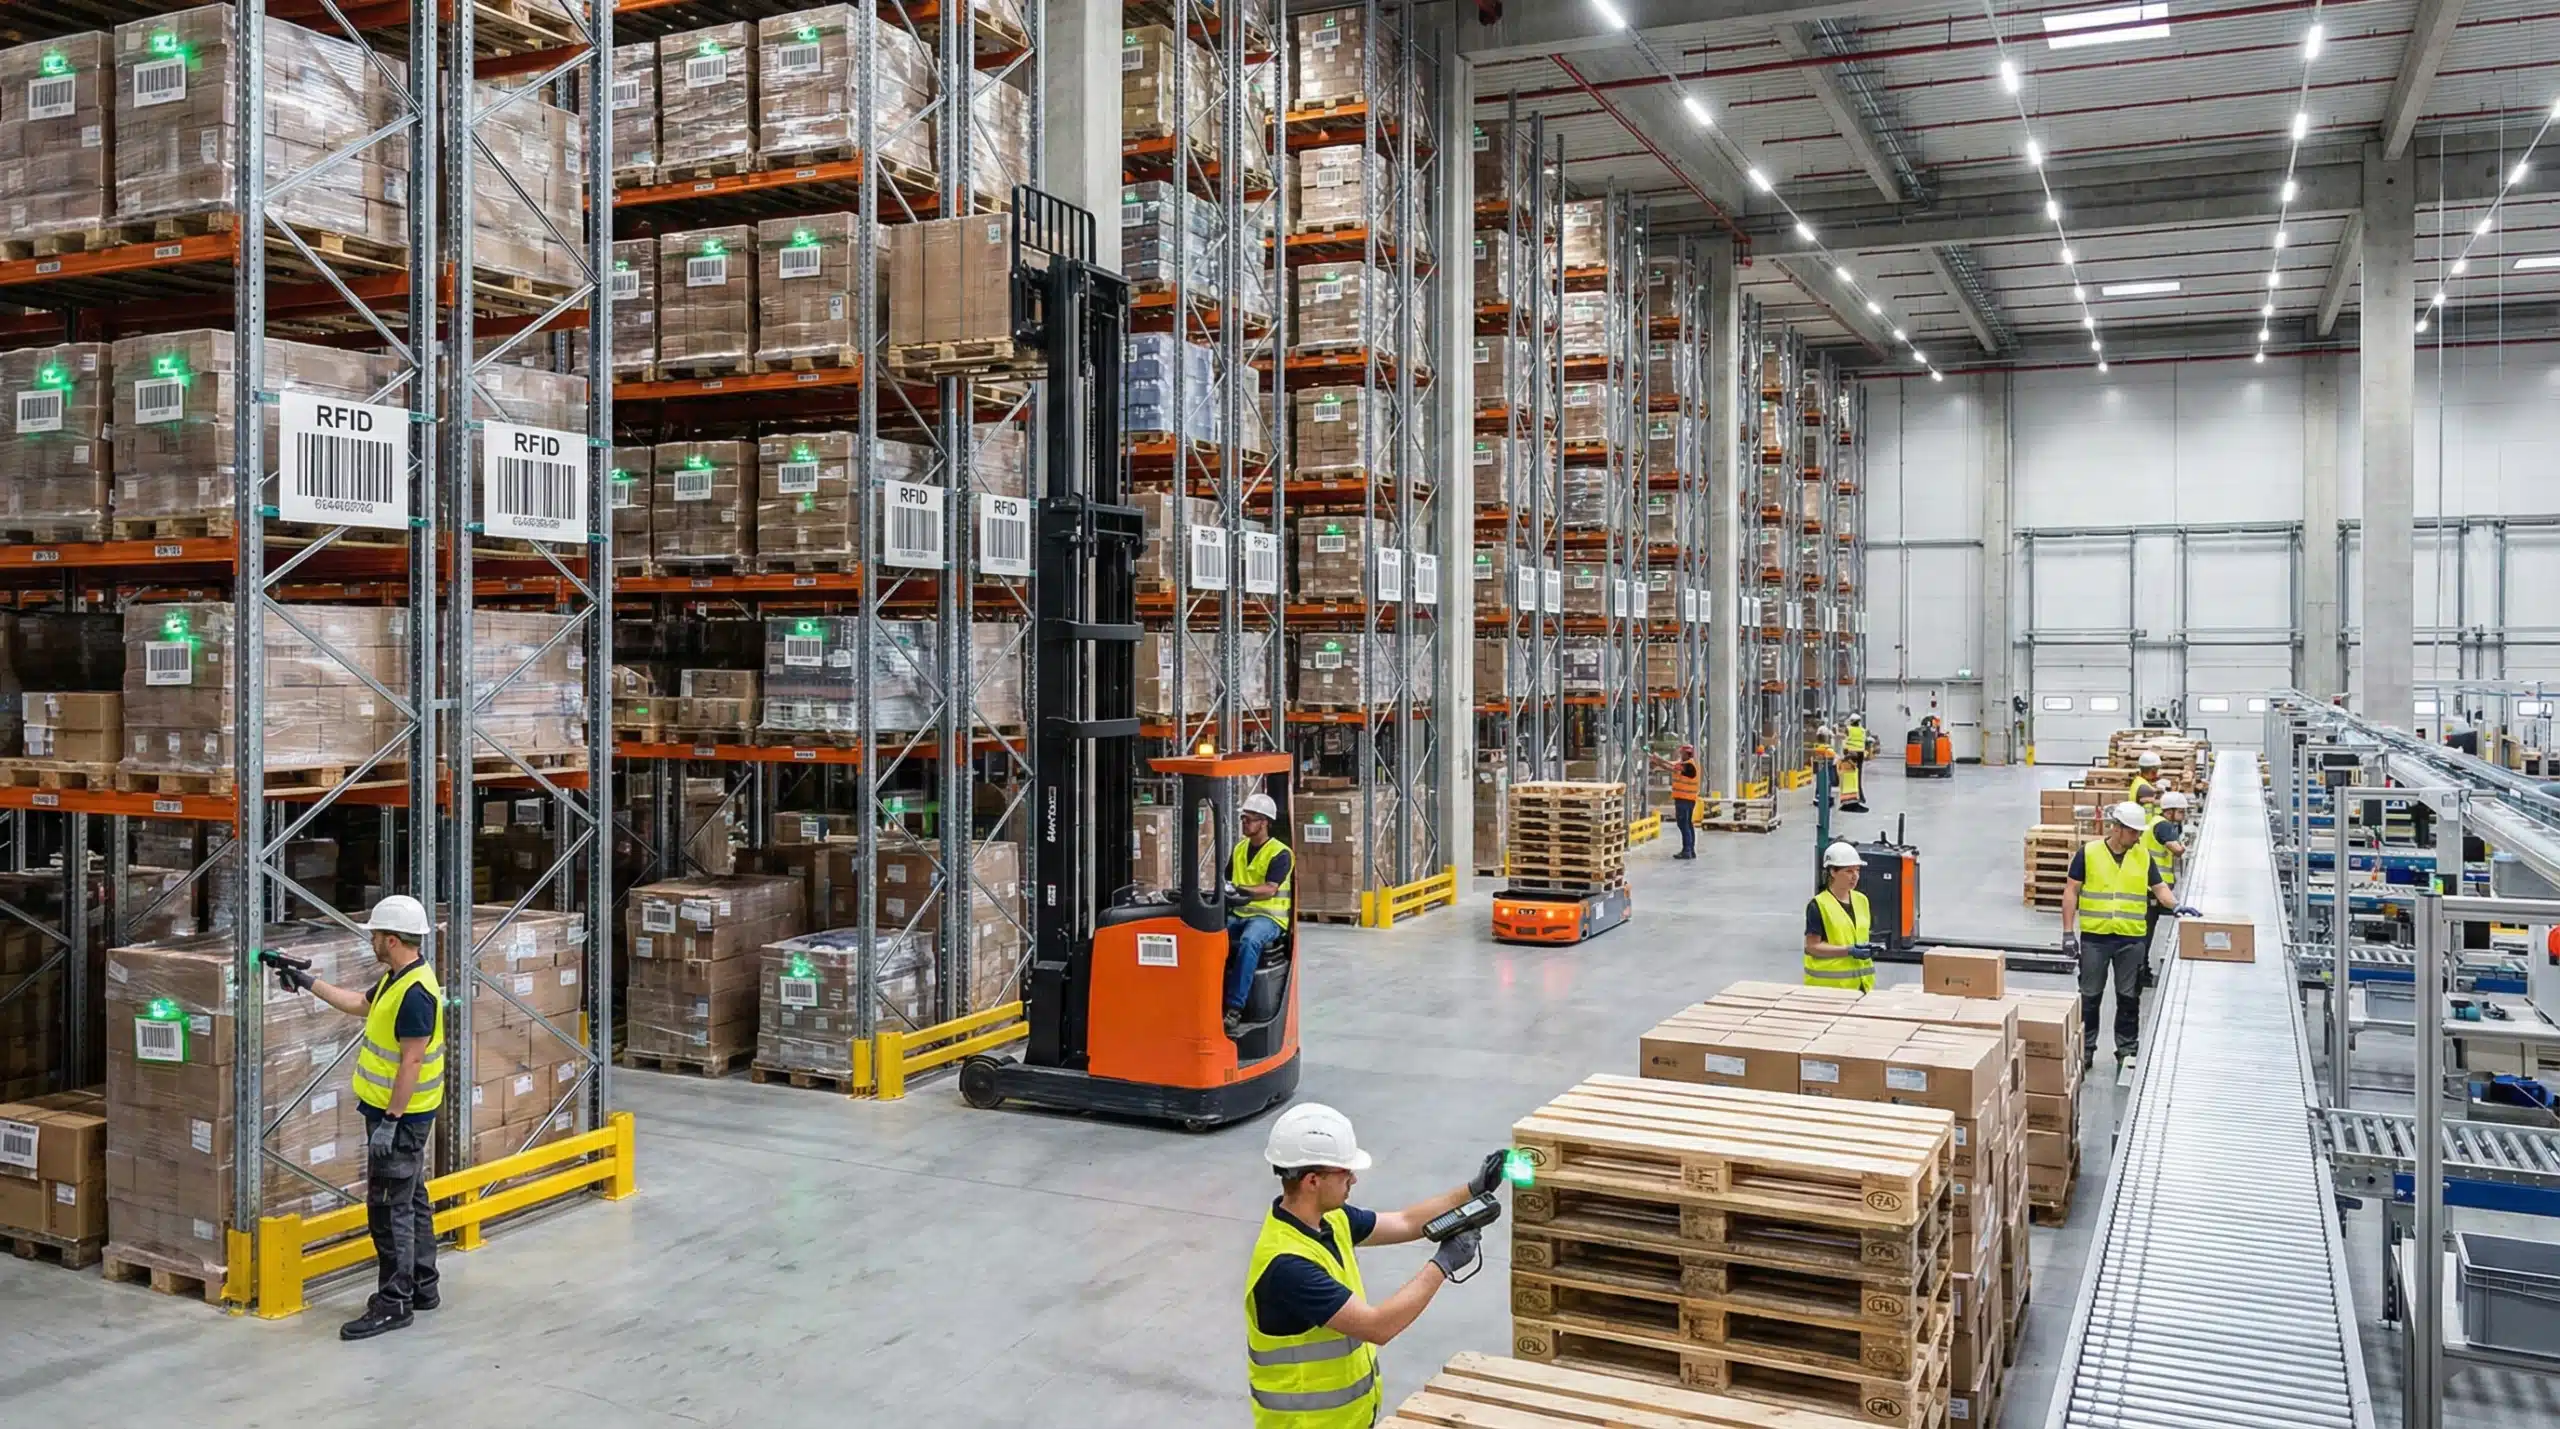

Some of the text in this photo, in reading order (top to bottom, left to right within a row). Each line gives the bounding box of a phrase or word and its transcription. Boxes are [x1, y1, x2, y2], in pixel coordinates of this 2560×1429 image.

[317, 405, 373, 432] RFID
[514, 432, 560, 456] RFID
[900, 487, 928, 505] RFID
[994, 500, 1018, 516] RFID
